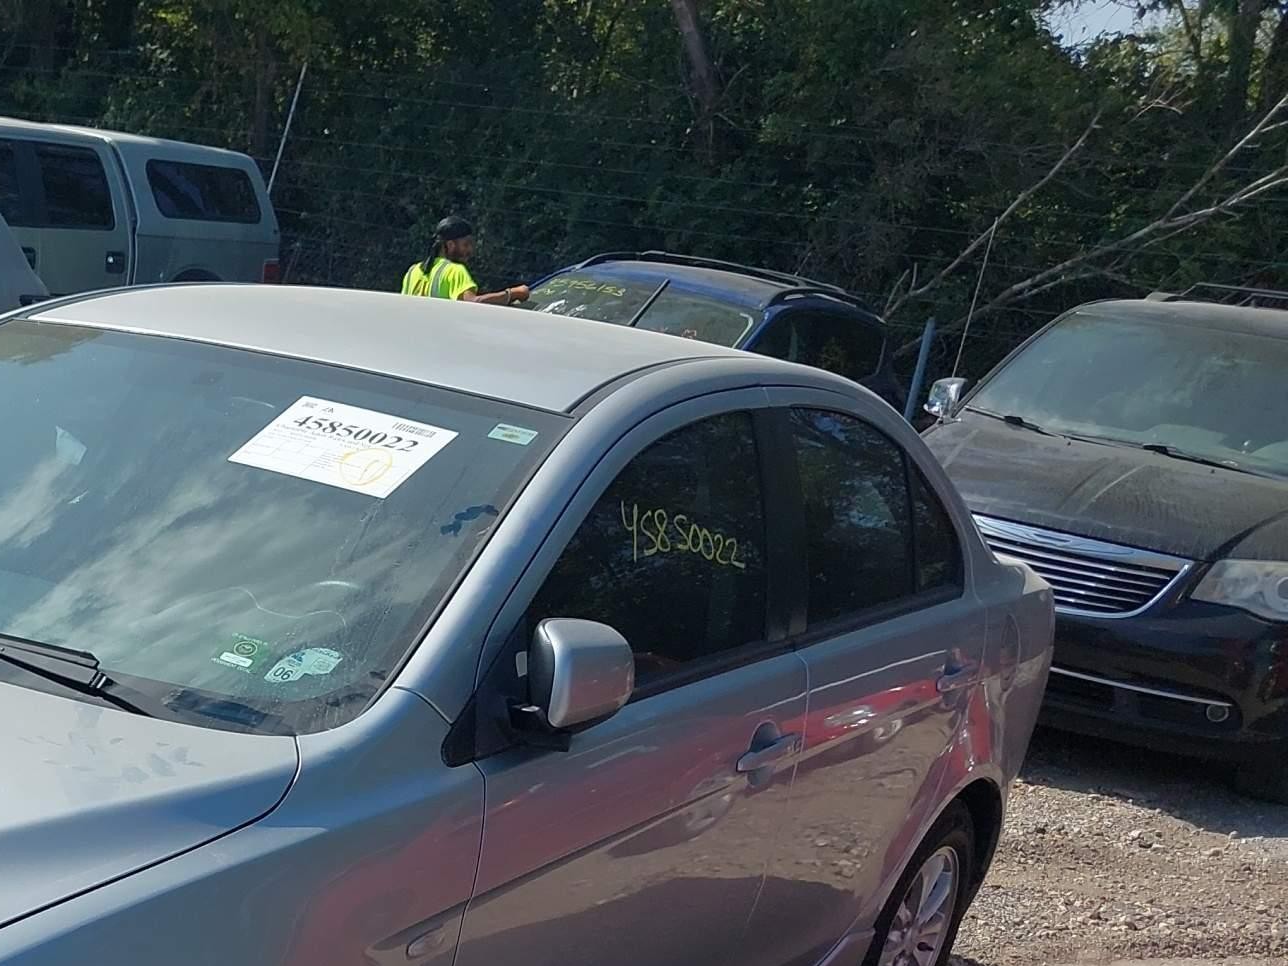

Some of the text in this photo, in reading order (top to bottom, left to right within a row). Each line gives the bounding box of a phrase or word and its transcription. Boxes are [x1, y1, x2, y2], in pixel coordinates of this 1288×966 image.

[293, 415, 419, 452] 45850022
[621, 500, 745, 568] 45850022
[273, 666, 294, 681] 06
